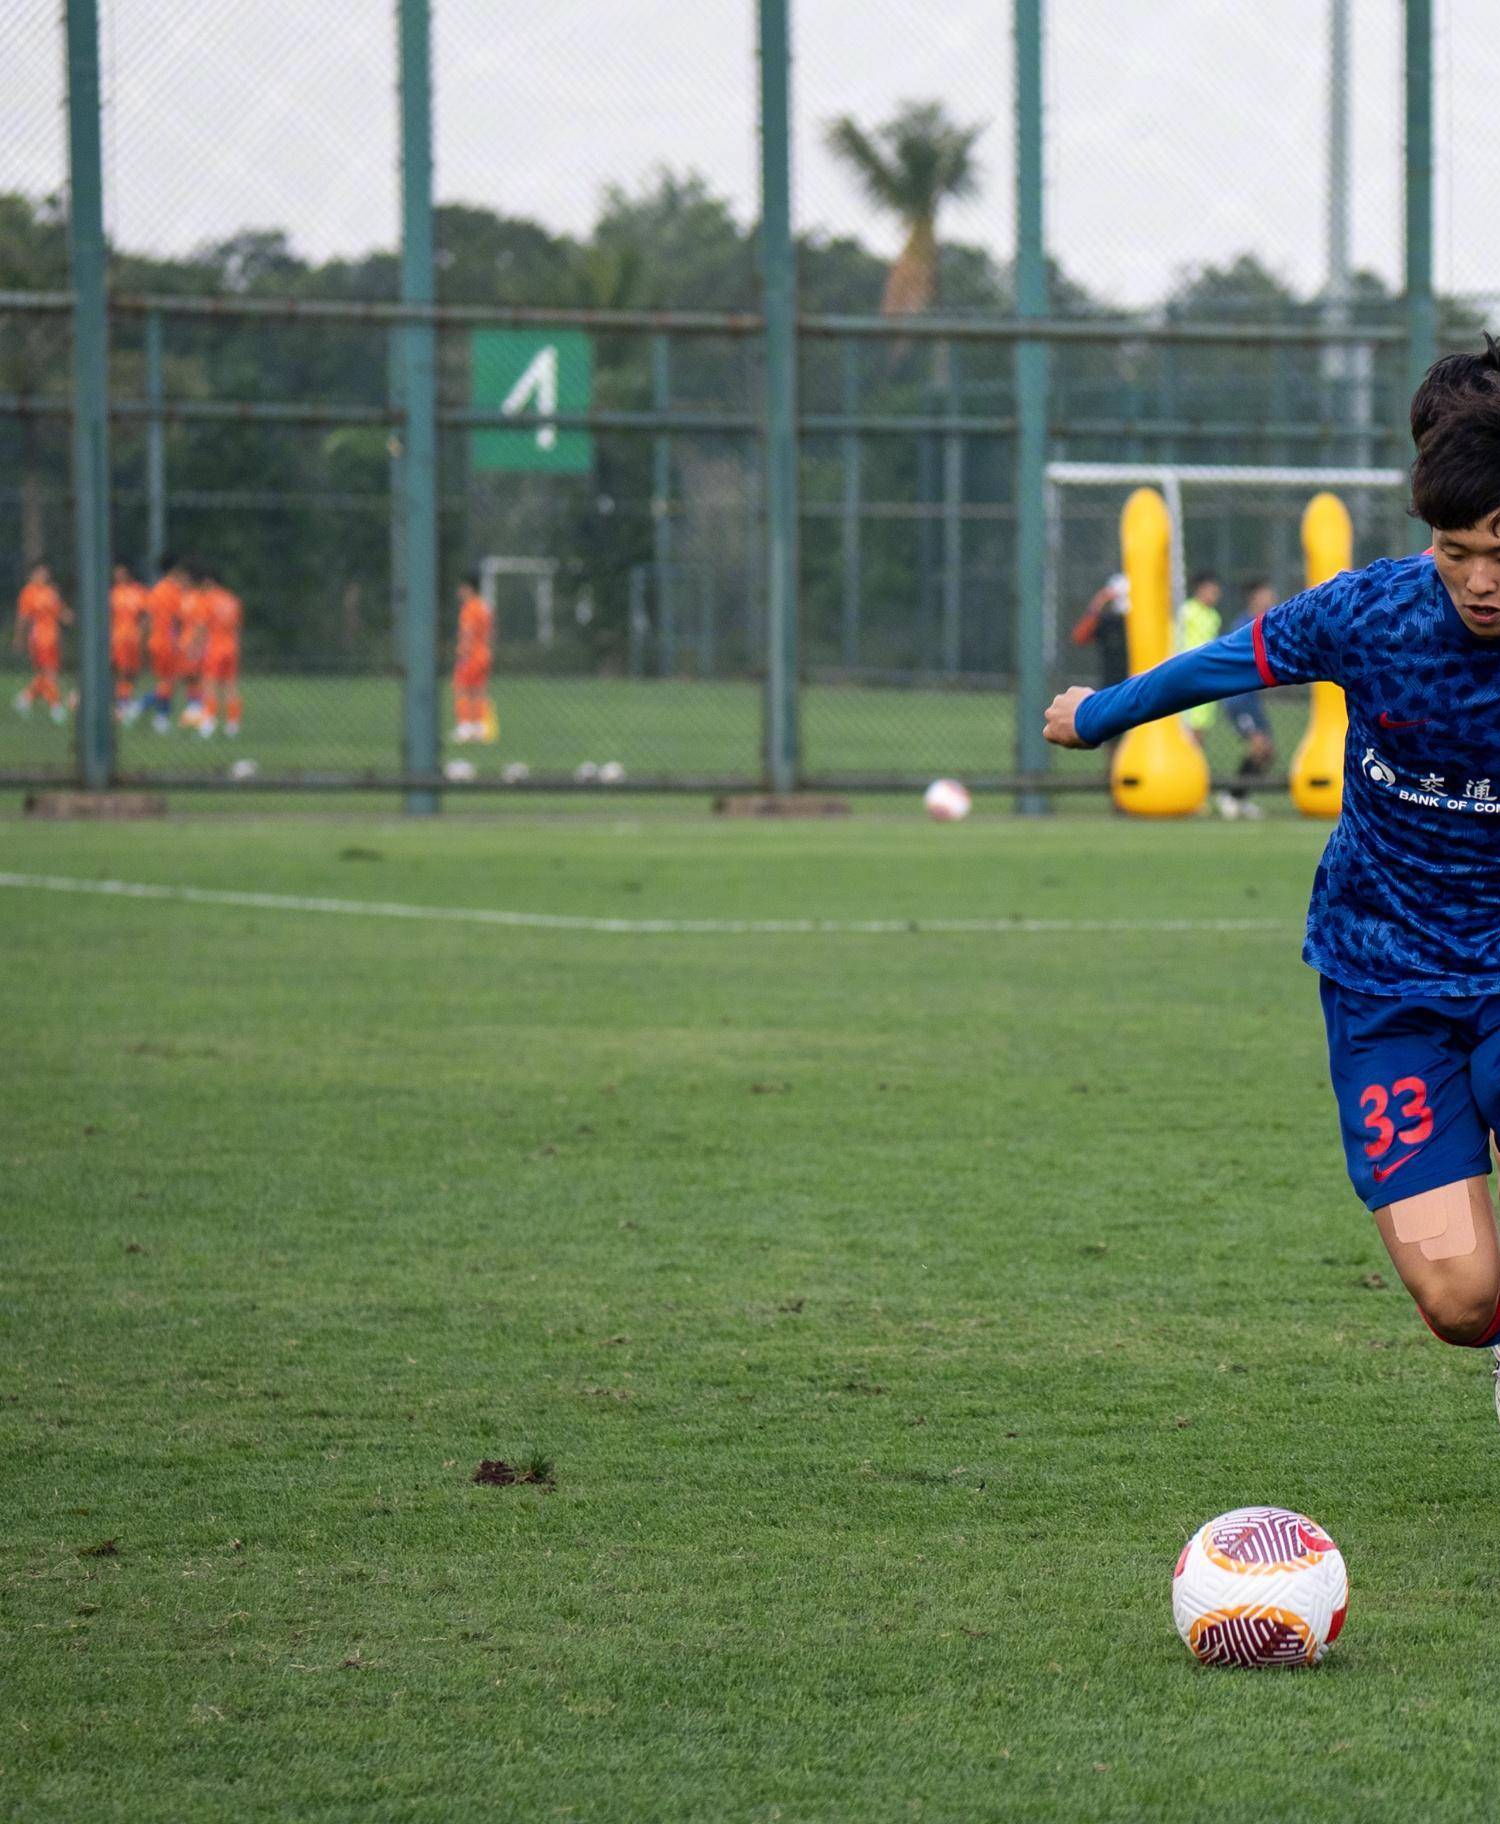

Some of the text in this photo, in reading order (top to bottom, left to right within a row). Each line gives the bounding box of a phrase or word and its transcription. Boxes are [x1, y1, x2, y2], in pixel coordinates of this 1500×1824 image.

[1399, 789, 1440, 807] BANK
[1447, 799, 1468, 811] OF
[1360, 1076, 1434, 1158] 33
